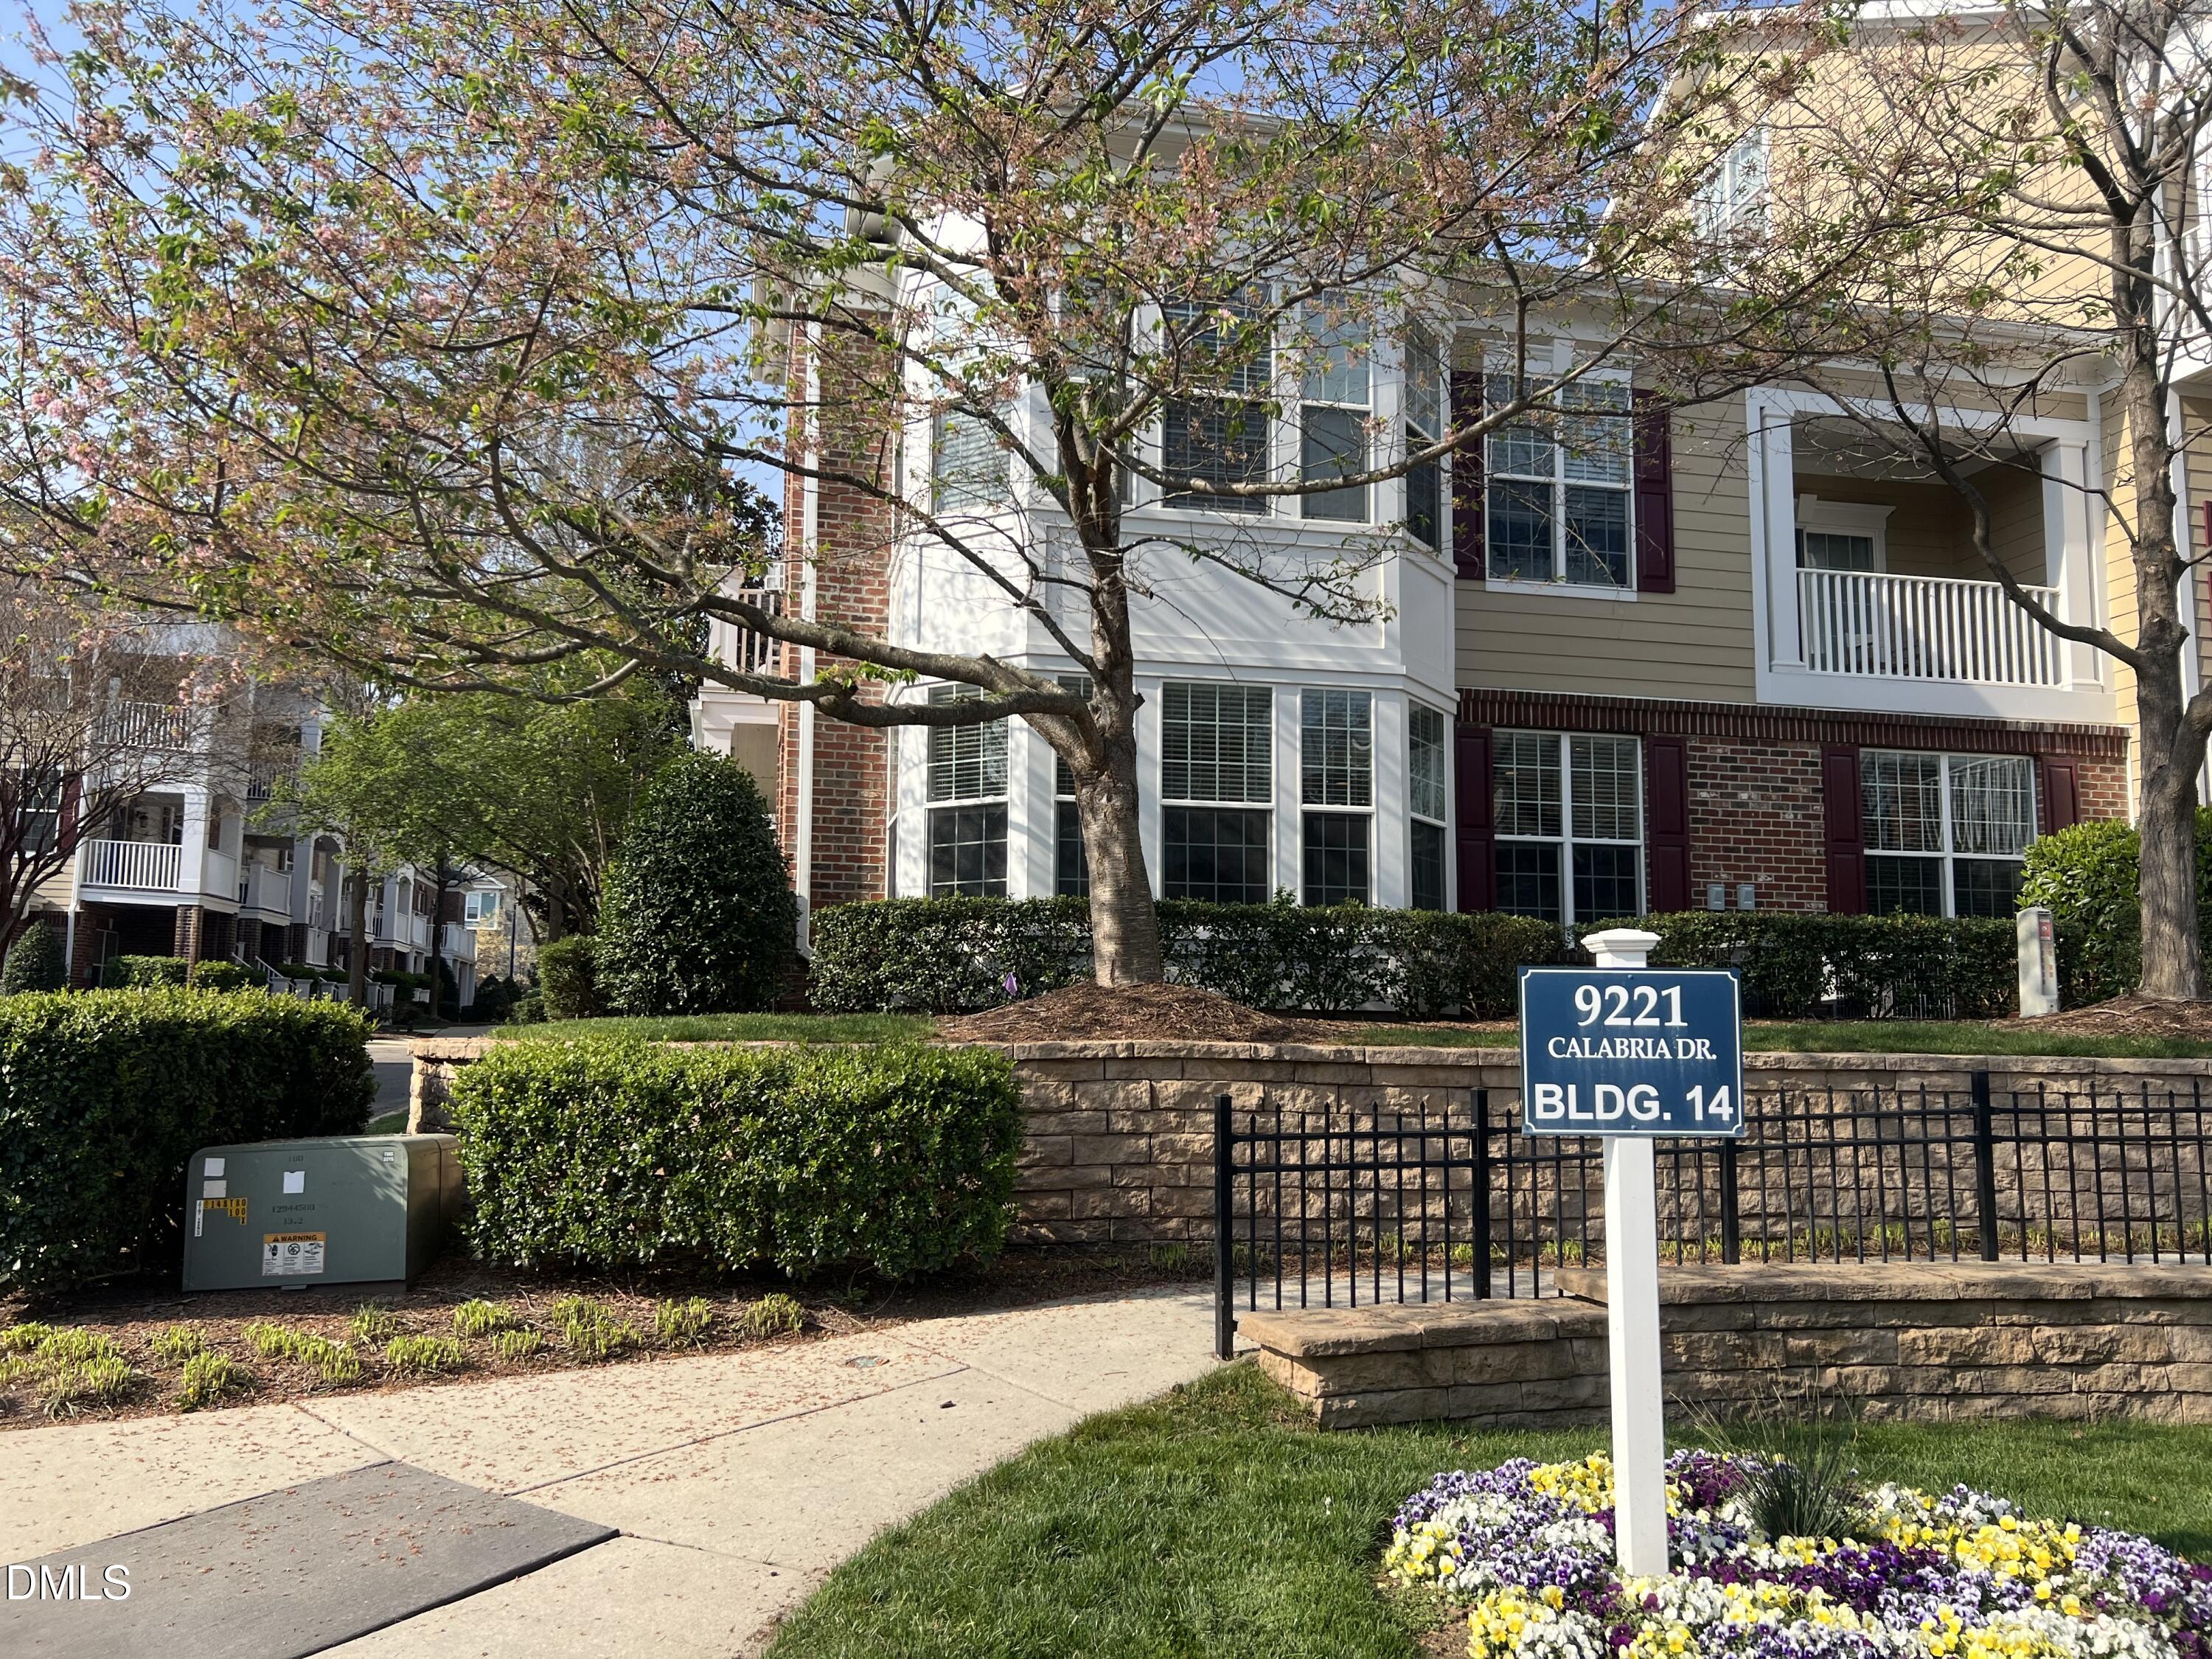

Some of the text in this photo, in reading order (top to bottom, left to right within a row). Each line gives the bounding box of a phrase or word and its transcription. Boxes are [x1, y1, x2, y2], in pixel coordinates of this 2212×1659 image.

[1574, 984, 1688, 1026] 9221
[1548, 1037, 1717, 1060] CALABRIA DR.
[1534, 1083, 1733, 1121] BLDG. 14
